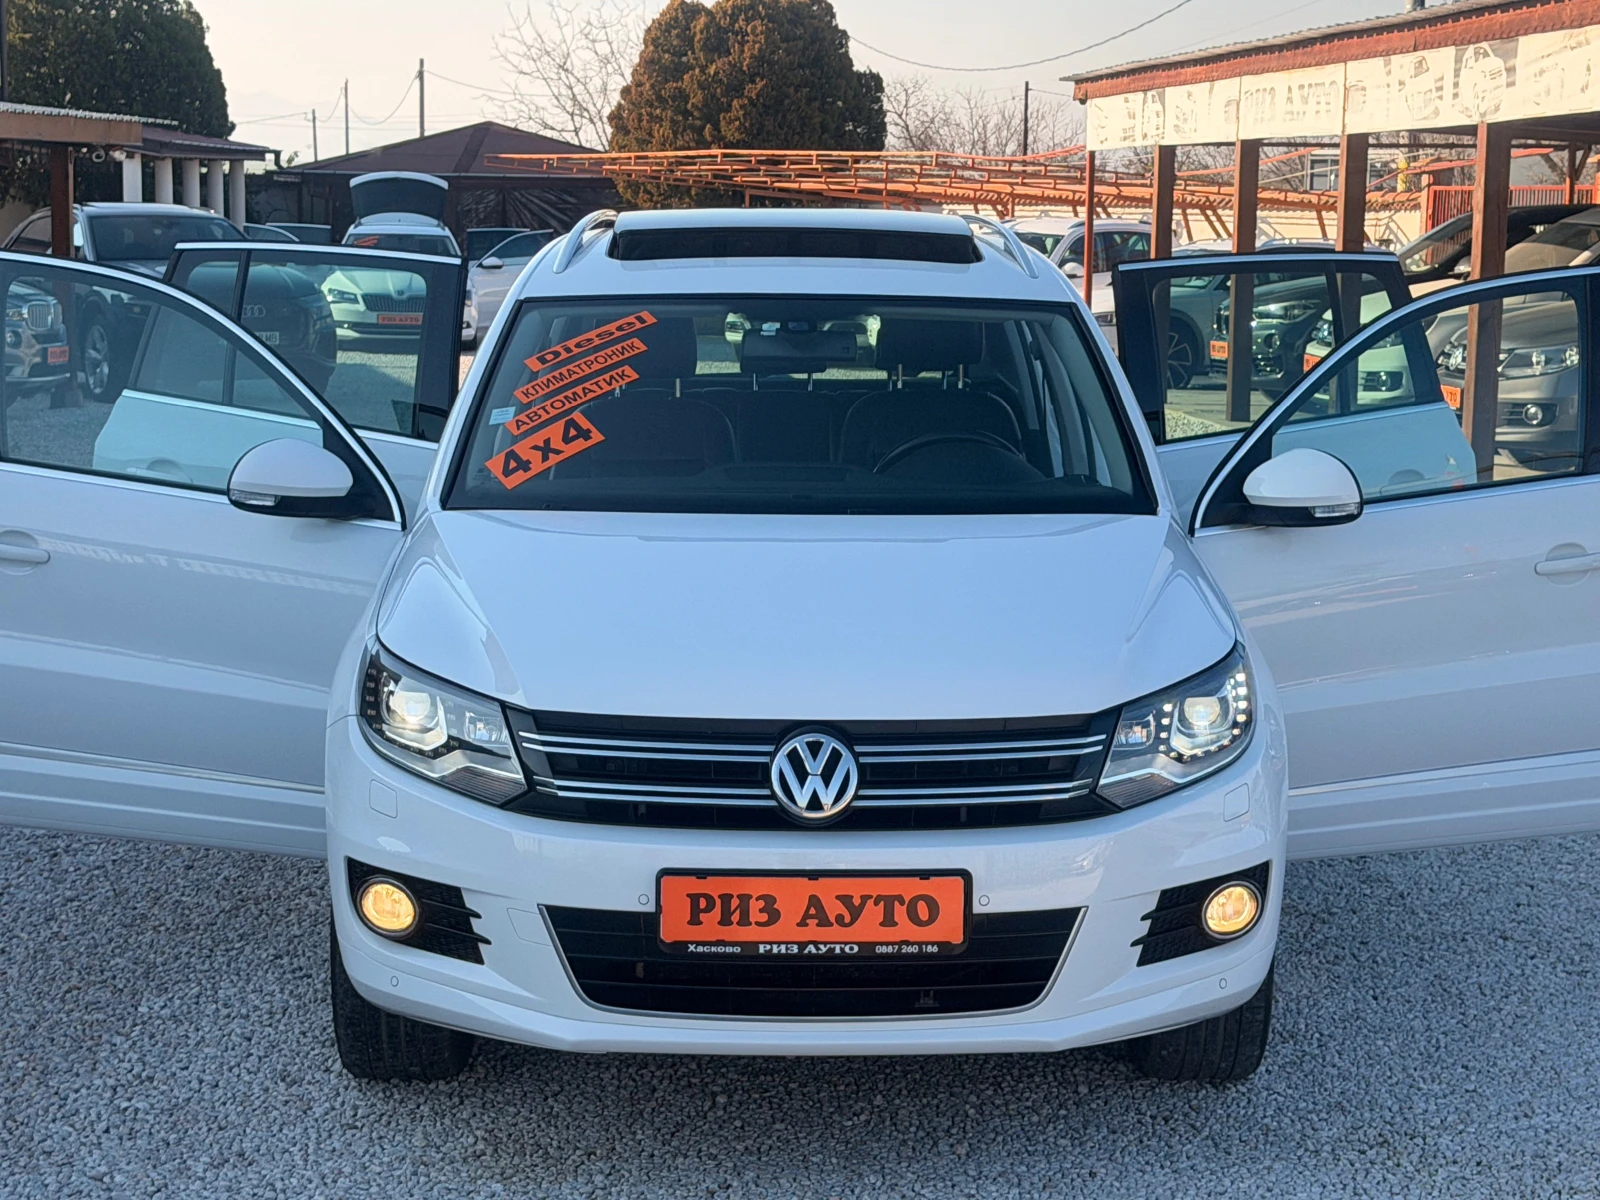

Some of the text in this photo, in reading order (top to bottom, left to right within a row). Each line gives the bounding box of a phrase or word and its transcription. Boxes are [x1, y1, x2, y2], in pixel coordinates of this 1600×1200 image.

[536, 315, 648, 366] Diesel
[521, 341, 642, 400] КЛИМАТРОНИК
[513, 368, 633, 431] АВТОМАТИК
[685, 892, 941, 928] РИЗ АУТО
[687, 943, 939, 954] Хасково РИЗ АУТО 0887 260 186
